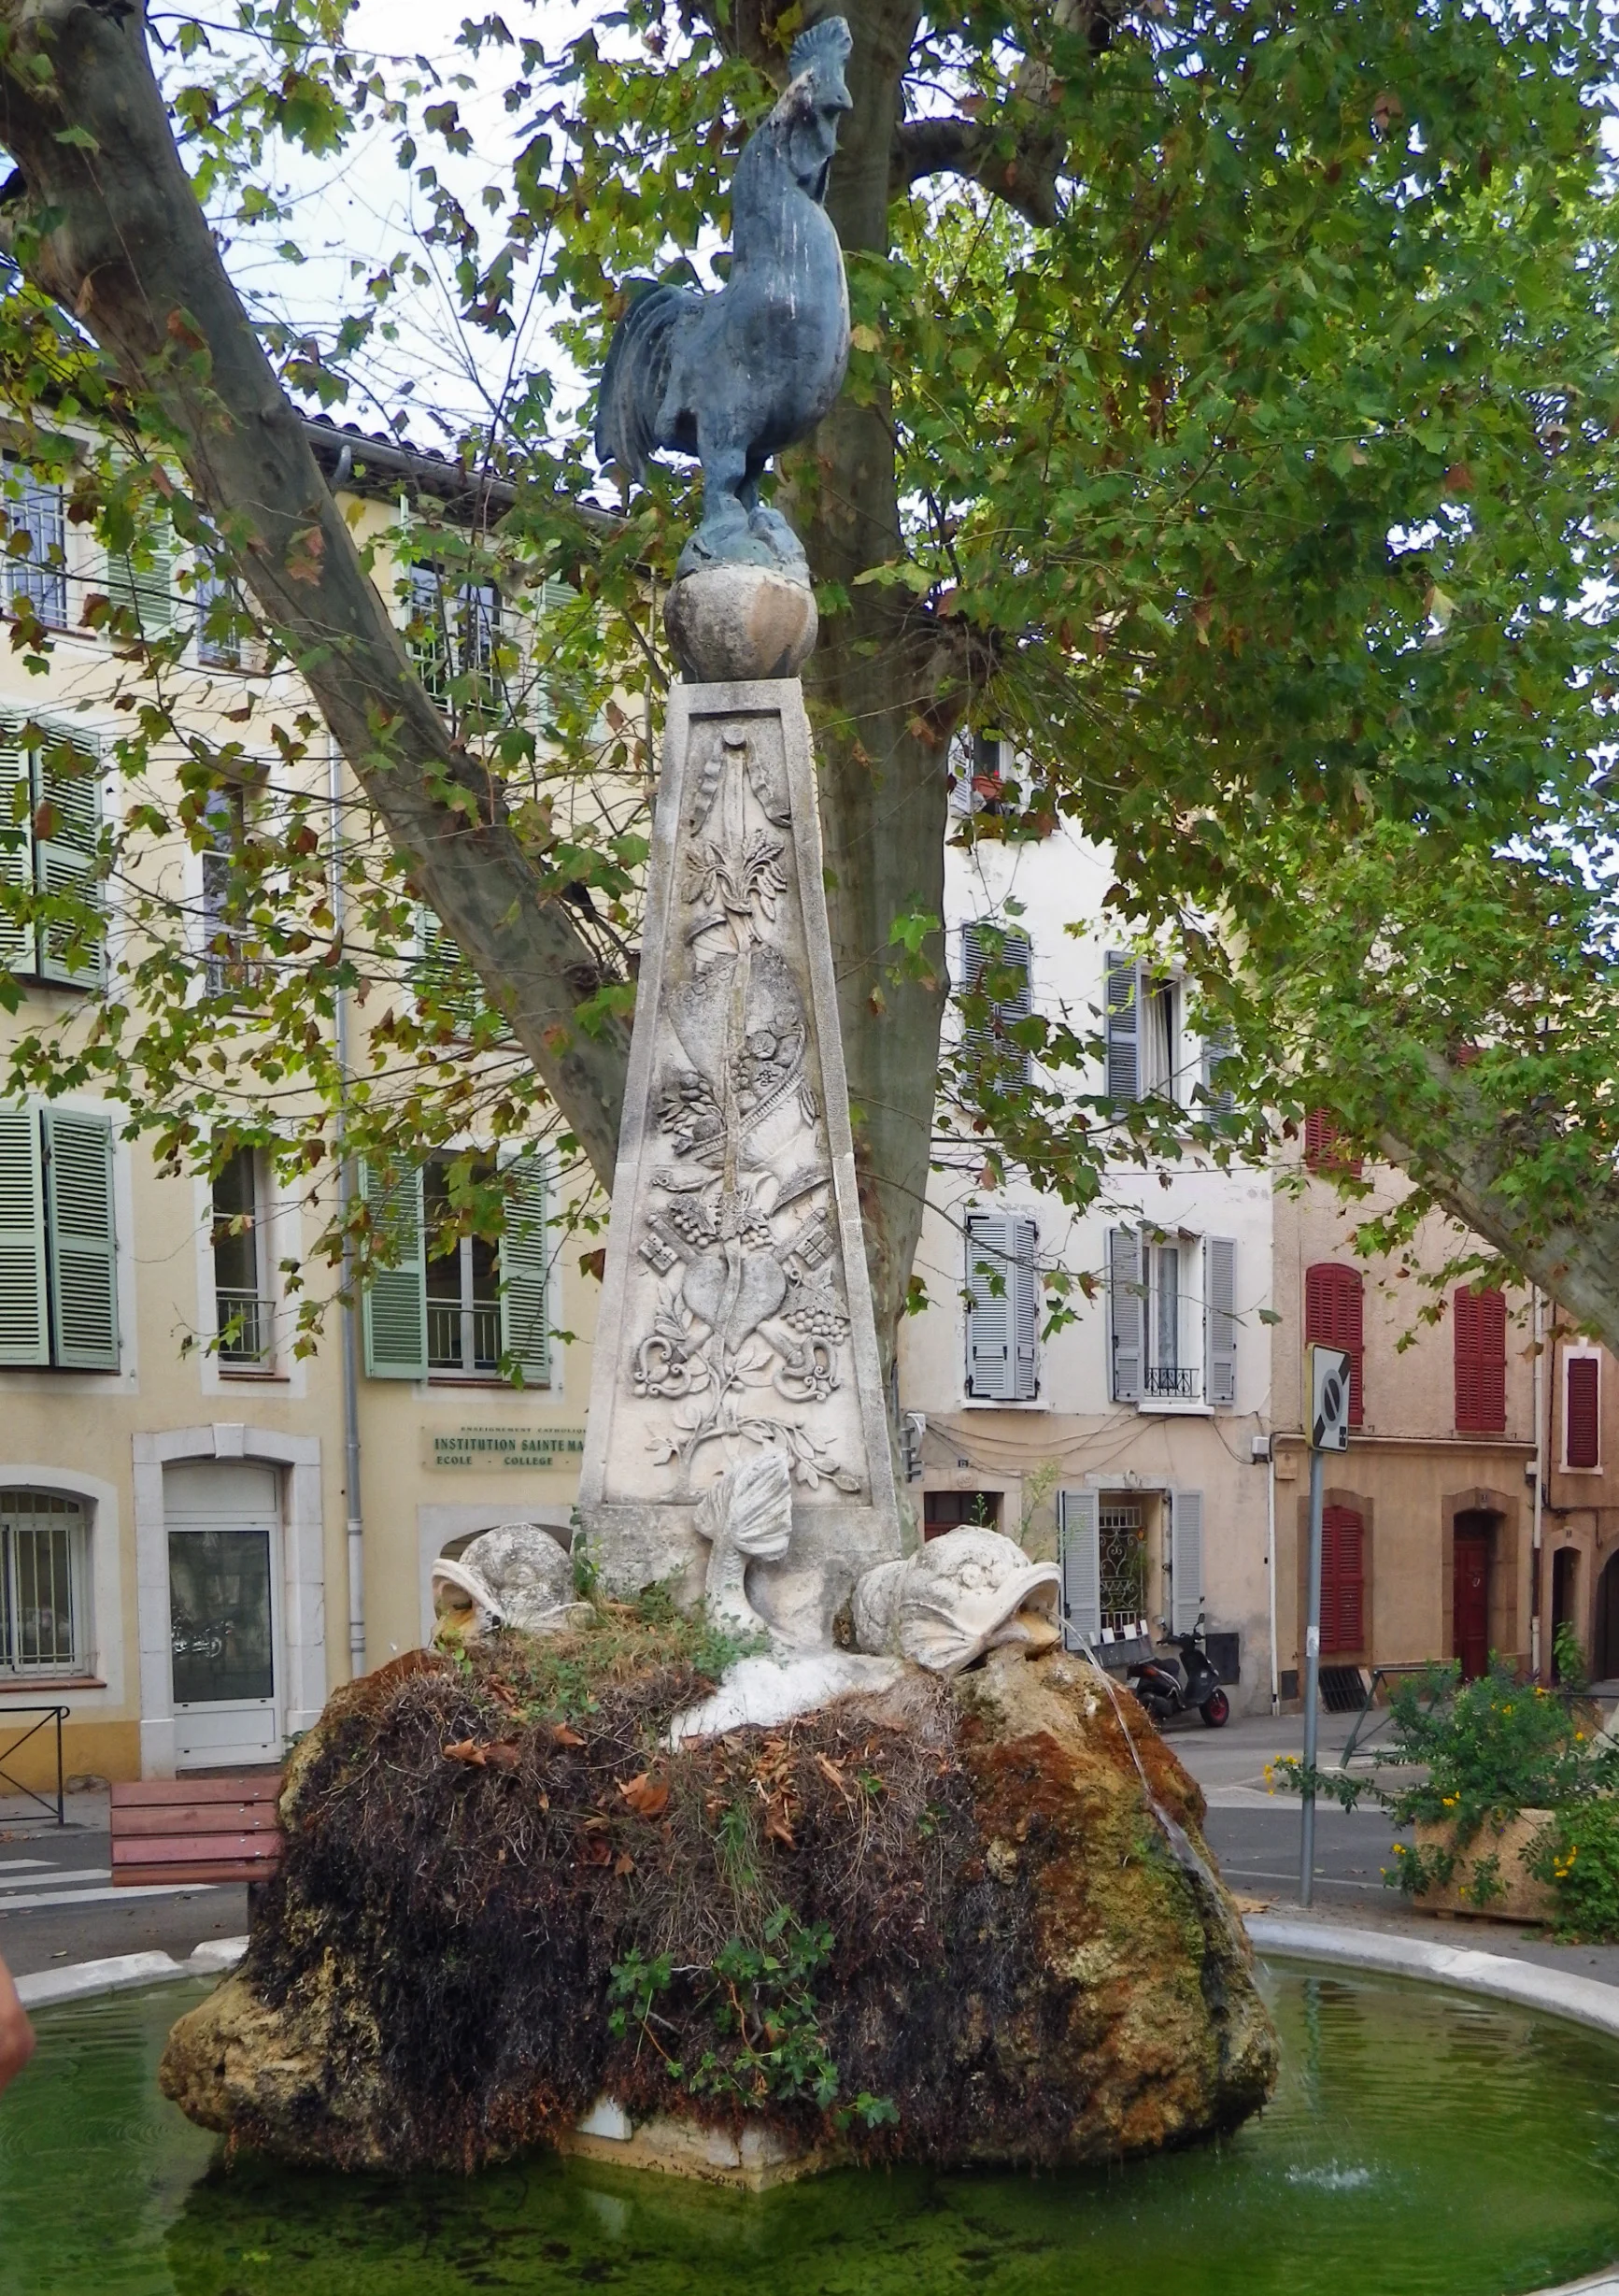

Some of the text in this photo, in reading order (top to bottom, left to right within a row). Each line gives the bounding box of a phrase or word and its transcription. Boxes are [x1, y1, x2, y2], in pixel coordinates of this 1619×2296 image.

[434, 1438, 516, 1450] INSTITUTION
[521, 1439, 564, 1451] SAINTE
[436, 1456, 473, 1465] ECOLE
[504, 1457, 553, 1465] COLLEGE
